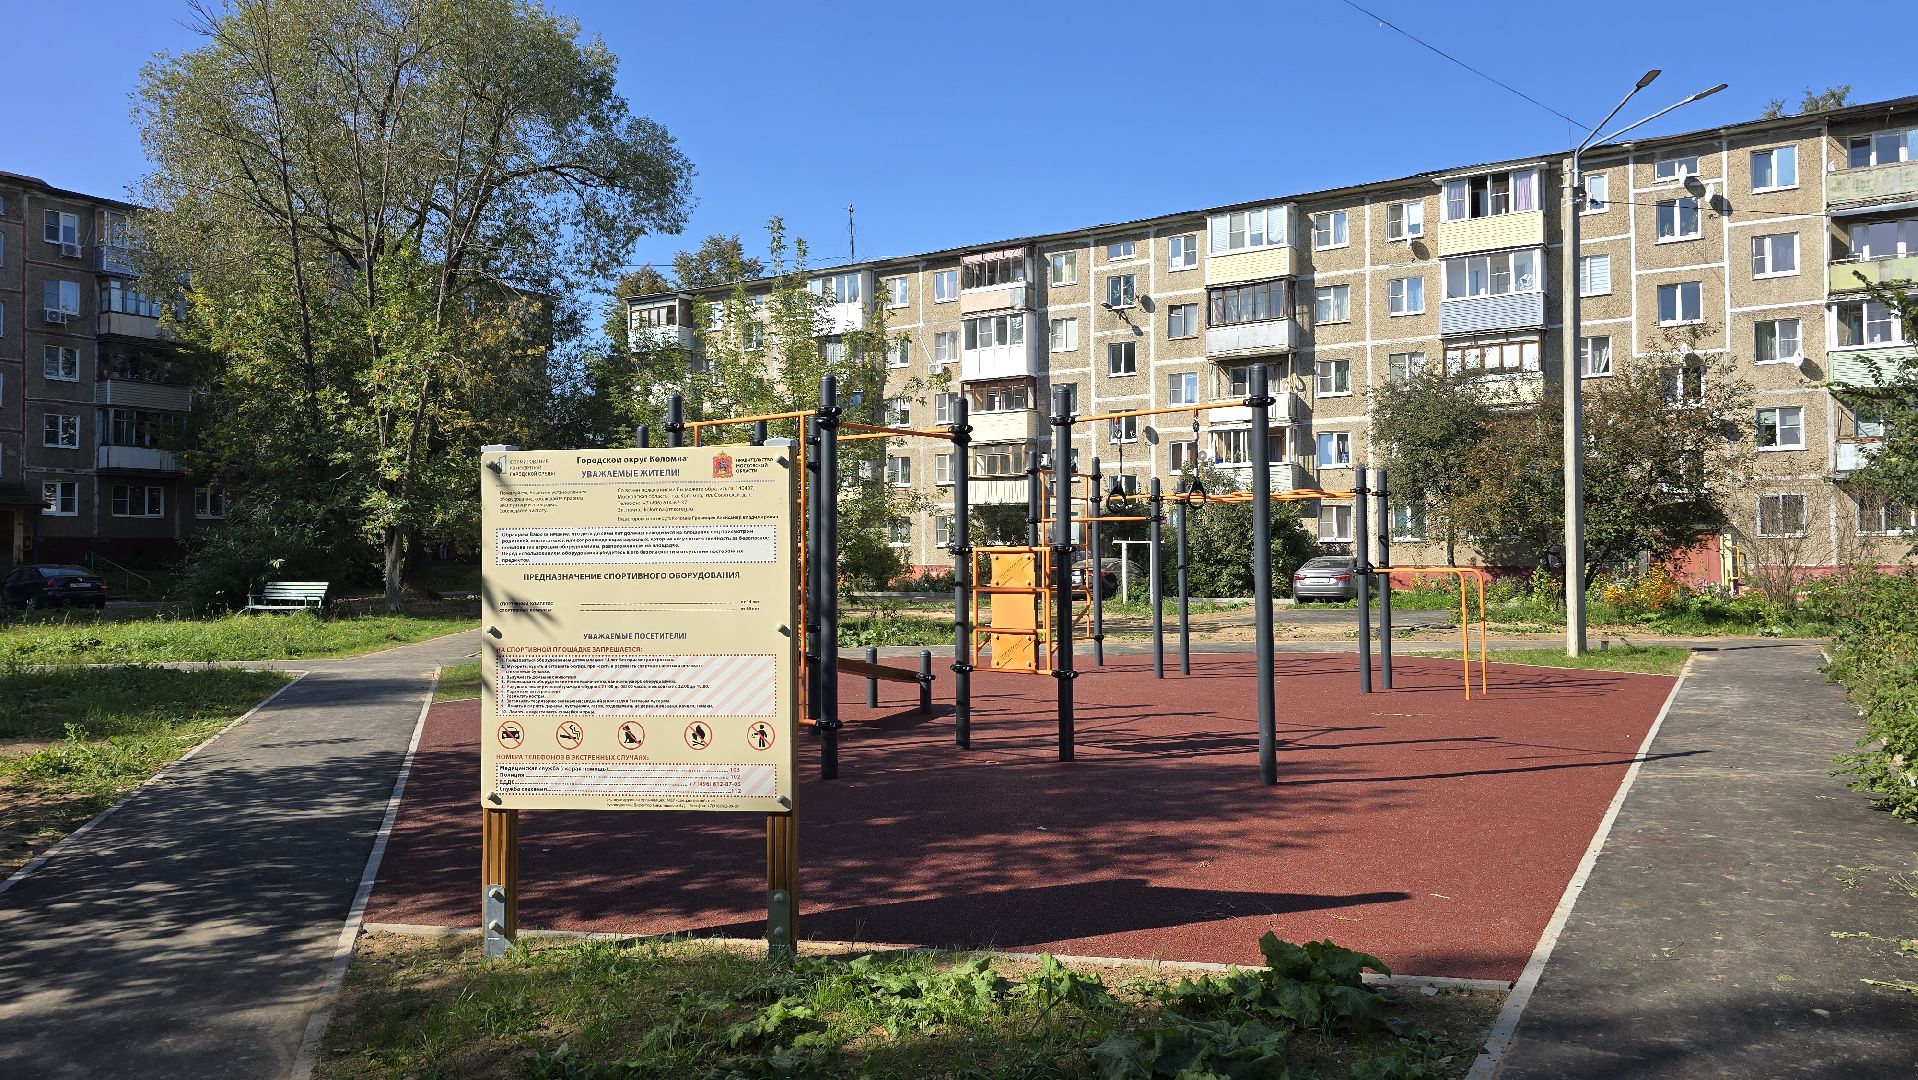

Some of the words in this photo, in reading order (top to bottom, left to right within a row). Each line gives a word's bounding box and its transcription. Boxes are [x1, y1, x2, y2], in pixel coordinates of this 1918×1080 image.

[623, 456, 648, 465] округ
[649, 455, 687, 463] Коломна
[581, 469, 639, 478] УВАЖАЕМЫЕ
[640, 468, 680, 477] ЖИТЕЛИ!
[523, 573, 601, 581] ПРЕДНАЗНАЧЕНИЕ
[603, 572, 667, 580] СПОРТИВНОГО
[668, 571, 740, 580] ОБОРУДОВАНИЯ
[583, 632, 633, 640] УВАЖАЕМЫЕ
[634, 632, 687, 640] ПОСЕТИТЕЛИ!
[506, 645, 552, 653] СПОРТИВНОЙ
[552, 646, 591, 654] ПЛОЩАДКЕ
